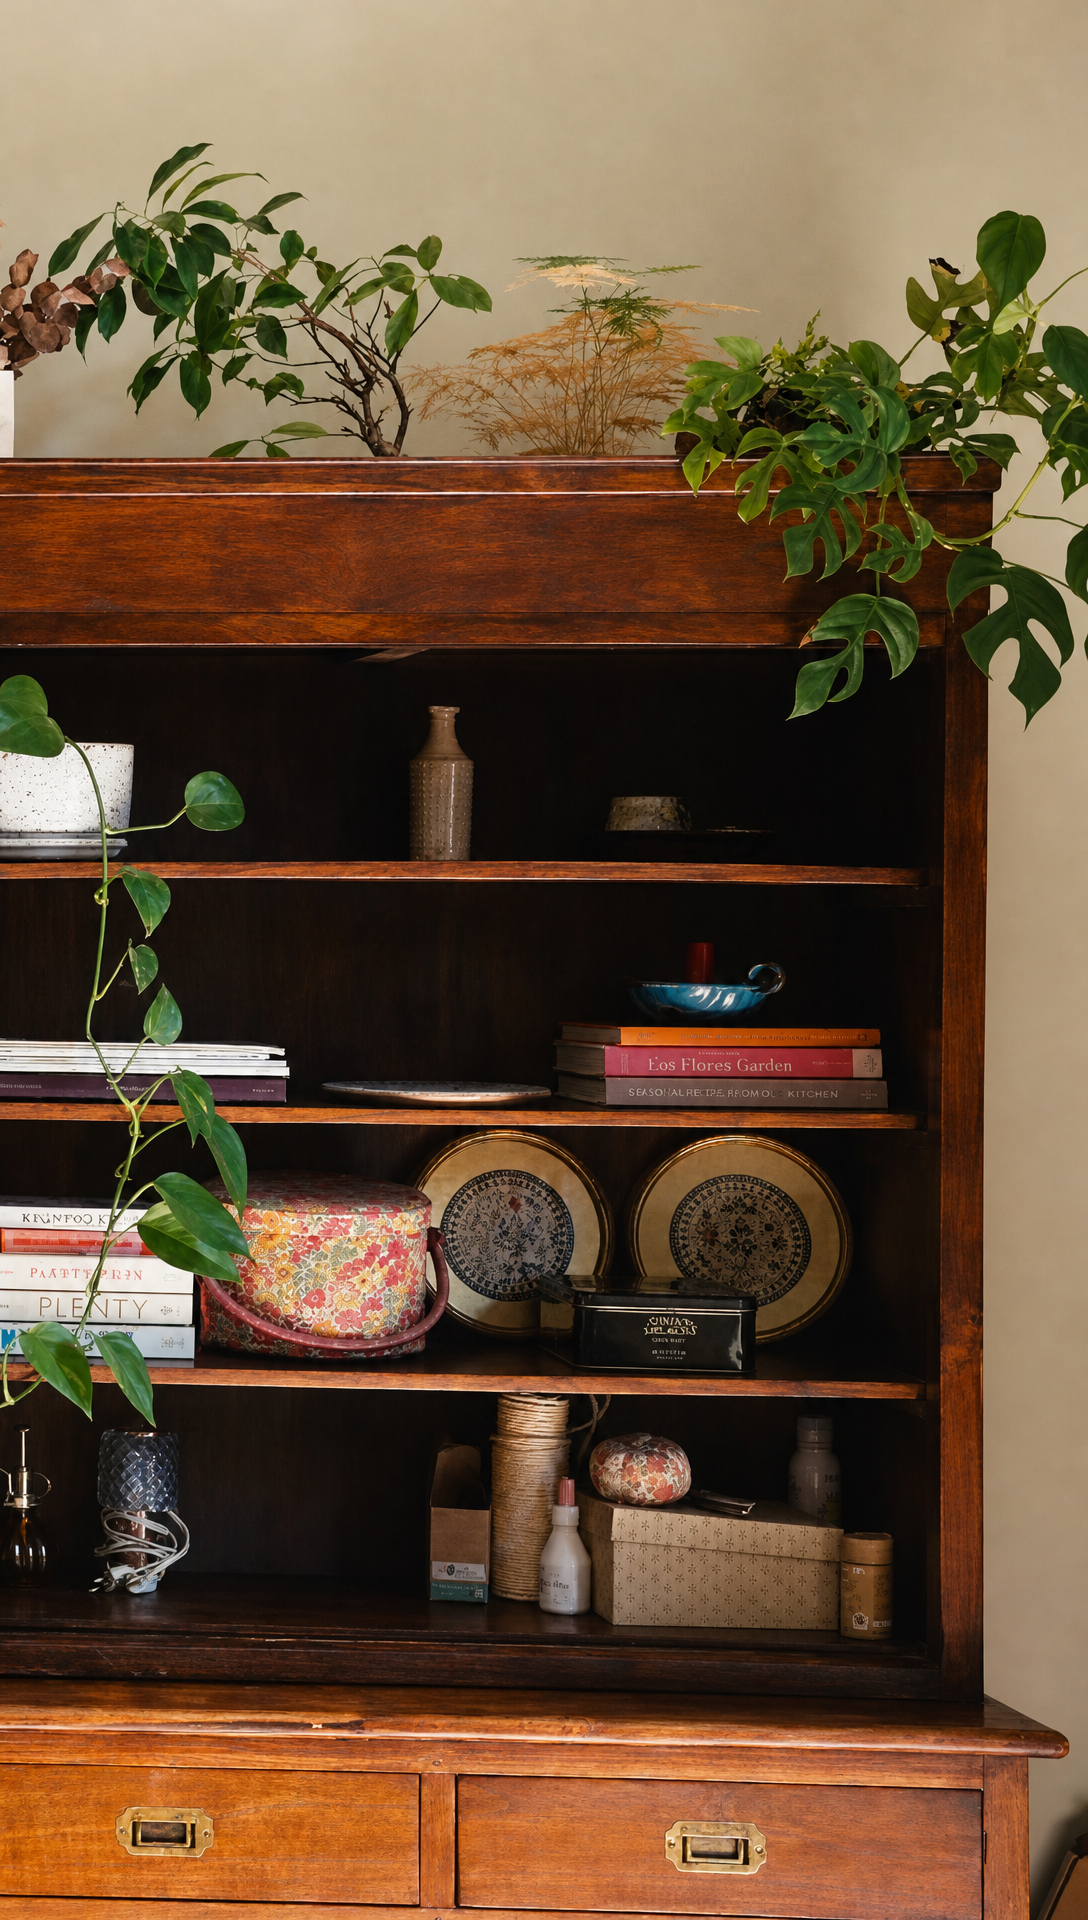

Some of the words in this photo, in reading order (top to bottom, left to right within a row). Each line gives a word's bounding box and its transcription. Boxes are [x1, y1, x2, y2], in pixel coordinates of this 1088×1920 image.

[681, 1057, 732, 1072] Flores
[737, 1057, 792, 1072] Garden
[787, 1090, 838, 1098] KITCHEN
[39, 1296, 148, 1320] PLENTY
